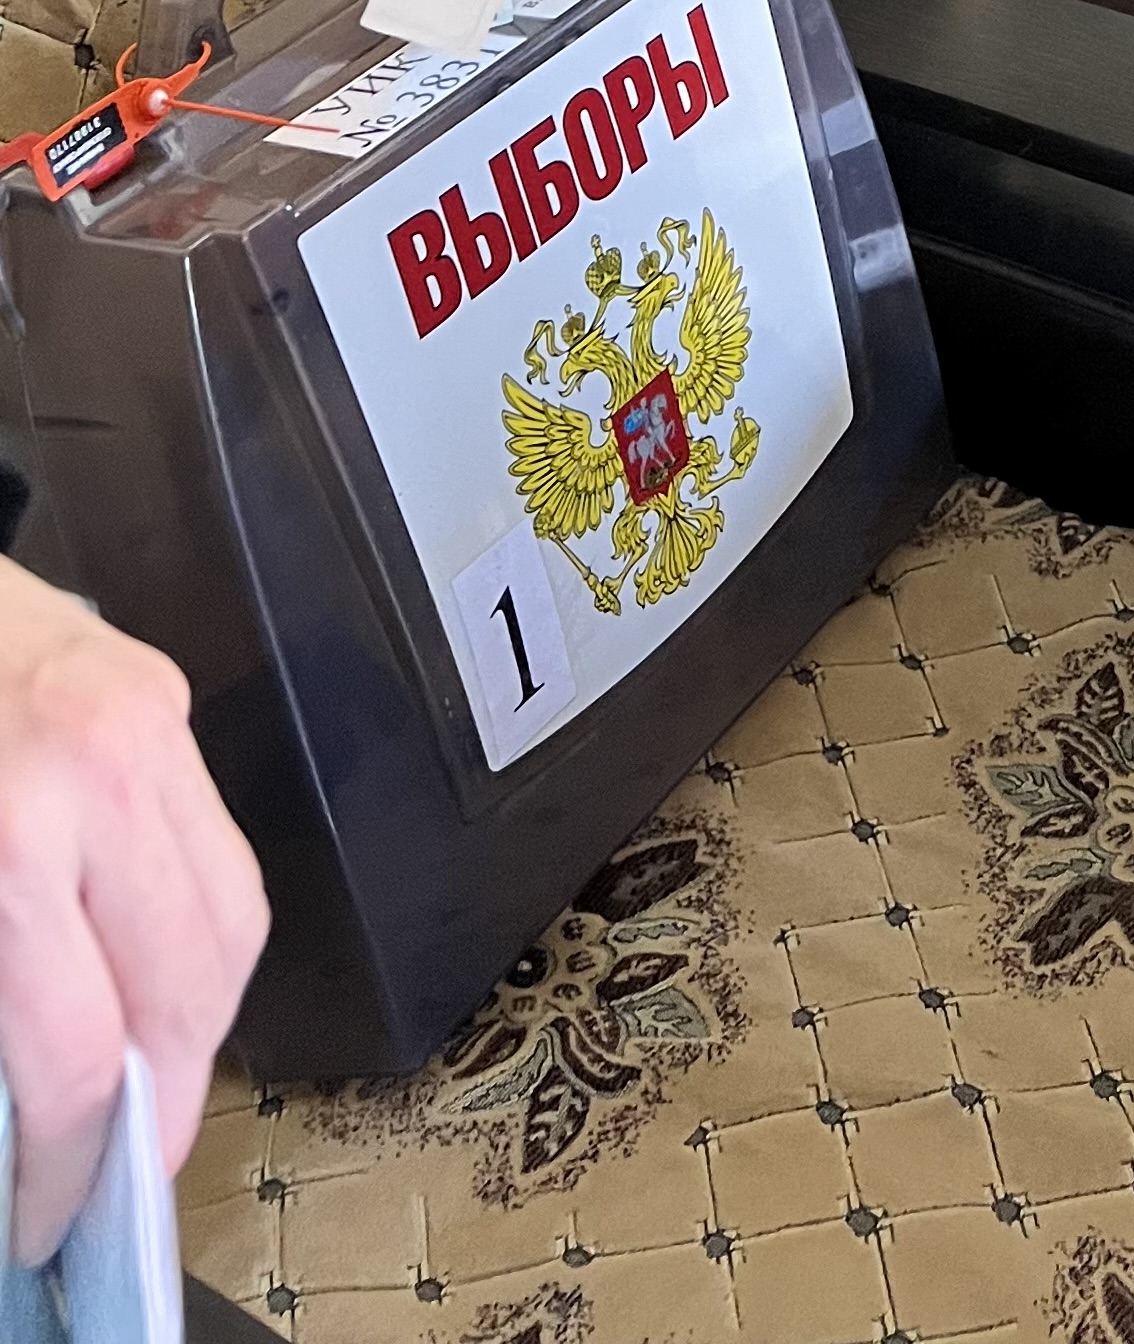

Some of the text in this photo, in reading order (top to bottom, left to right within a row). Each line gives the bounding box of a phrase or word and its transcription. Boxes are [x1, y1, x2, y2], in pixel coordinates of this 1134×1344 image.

[309, 51, 432, 116] УИК
[385, 3, 731, 340] ВЫБОРЫ
[489, 585, 545, 713] 1
